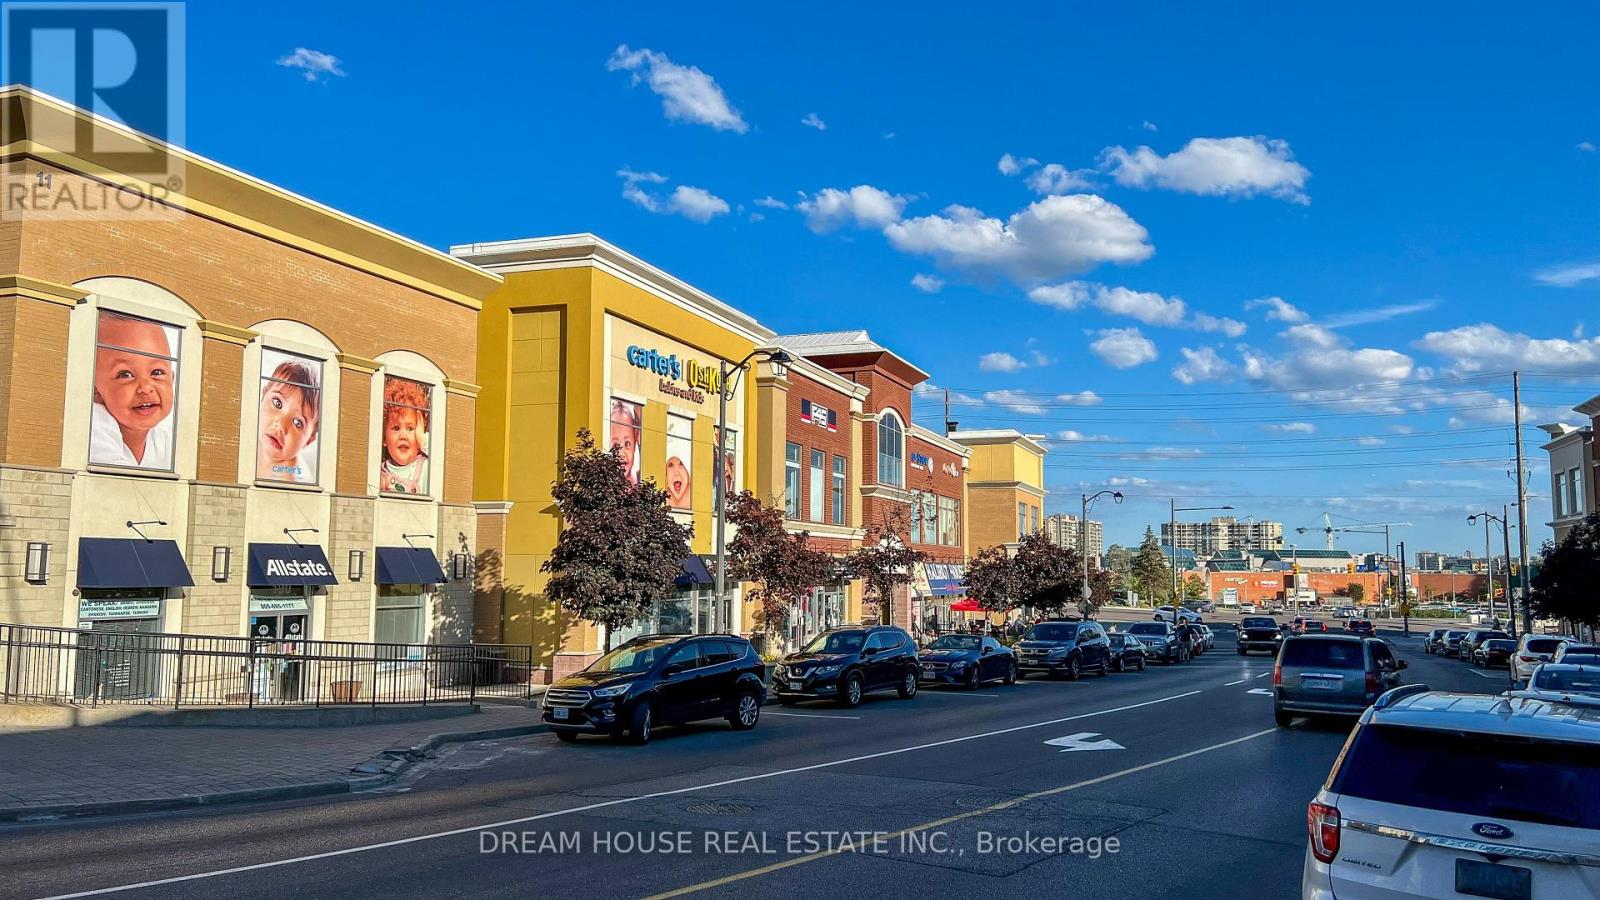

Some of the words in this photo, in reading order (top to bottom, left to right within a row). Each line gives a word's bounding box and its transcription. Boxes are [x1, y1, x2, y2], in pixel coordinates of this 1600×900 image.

[627, 345, 680, 380] carter's
[272, 465, 302, 475] carter's
[1479, 824, 1504, 837] Ford
